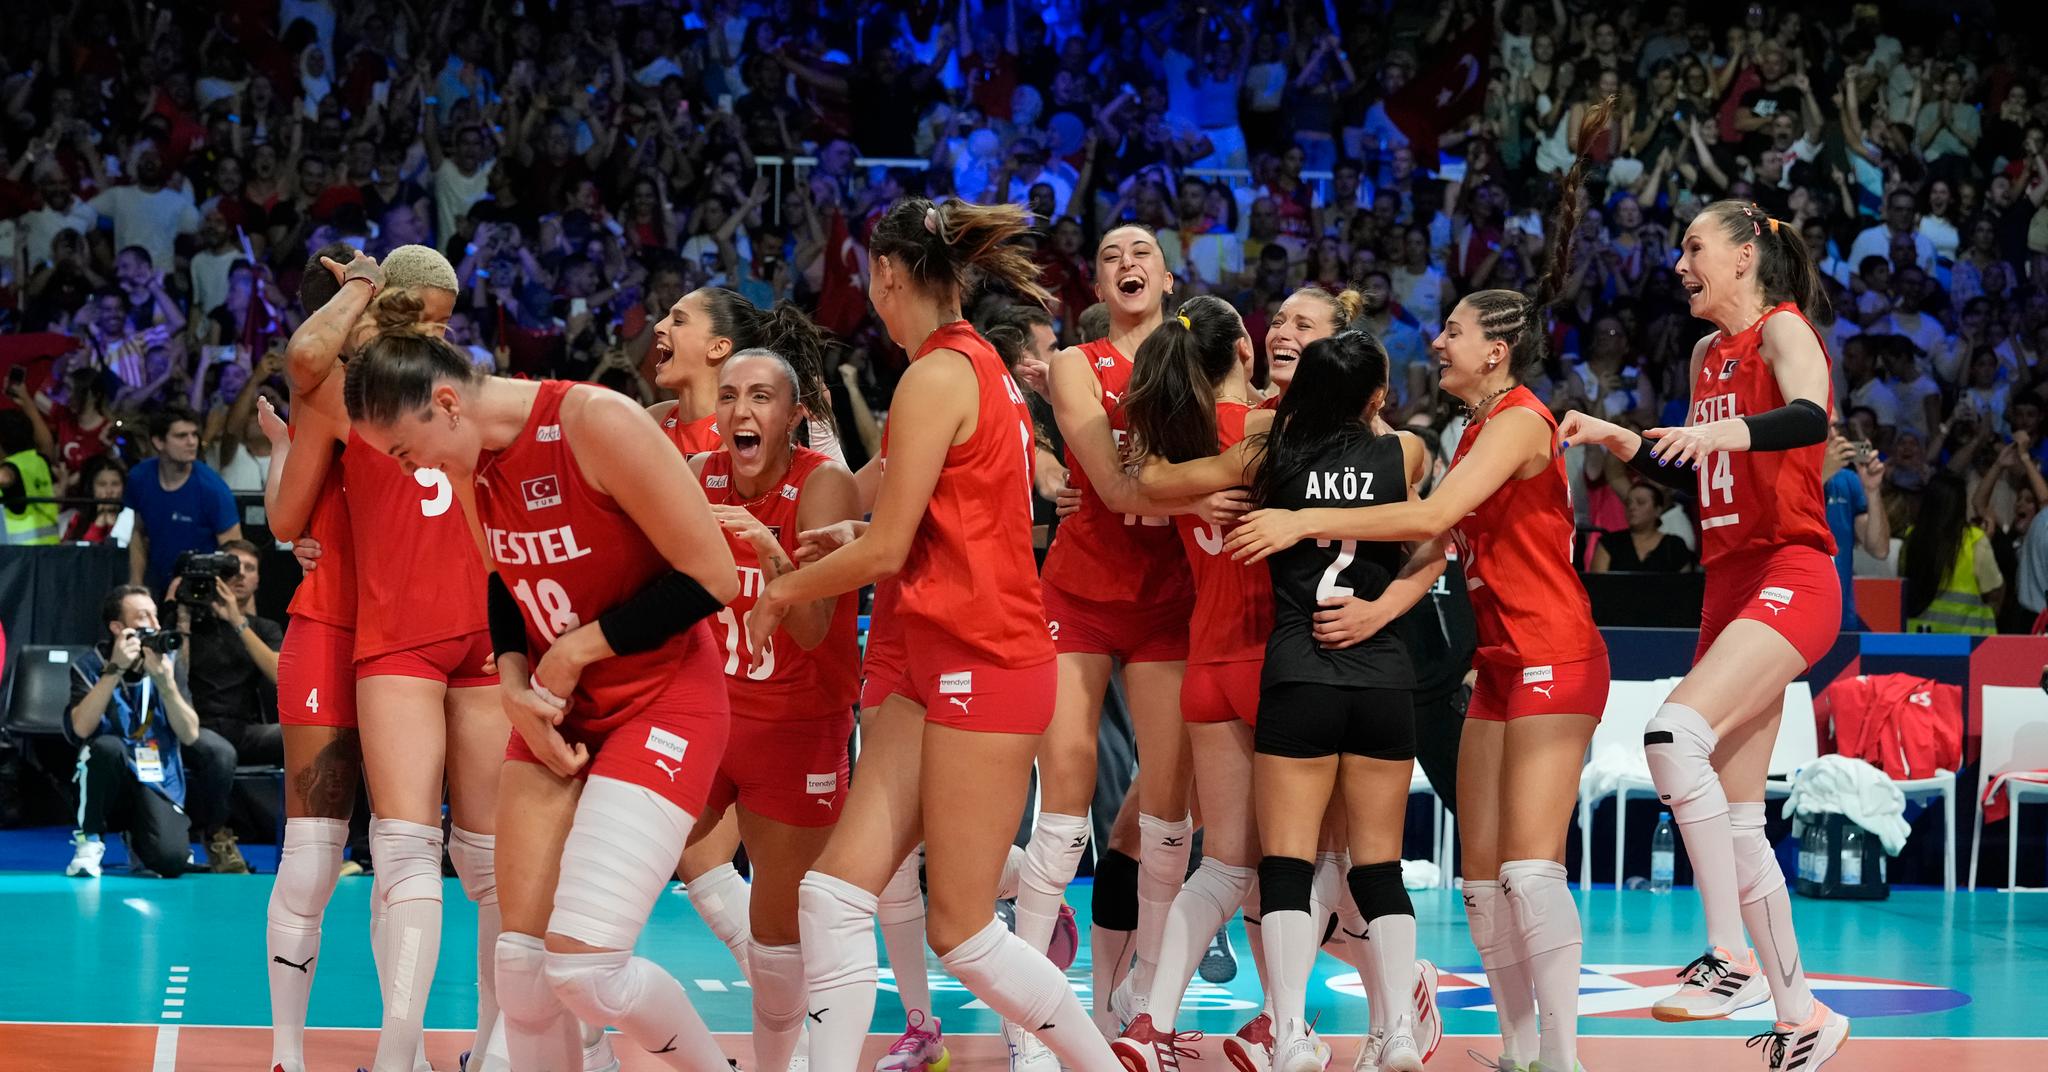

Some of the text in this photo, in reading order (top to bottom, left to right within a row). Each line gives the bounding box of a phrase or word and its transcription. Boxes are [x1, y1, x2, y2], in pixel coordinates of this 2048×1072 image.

[1305, 466, 1375, 500] AKÖZ
[1701, 451, 1734, 508] 14
[535, 499, 553, 507] TUR
[1316, 538, 1357, 604] 2
[513, 579, 580, 645] 18
[941, 679, 970, 687] trendyol
[305, 687, 319, 714] 4
[808, 780, 836, 788] trendyo
